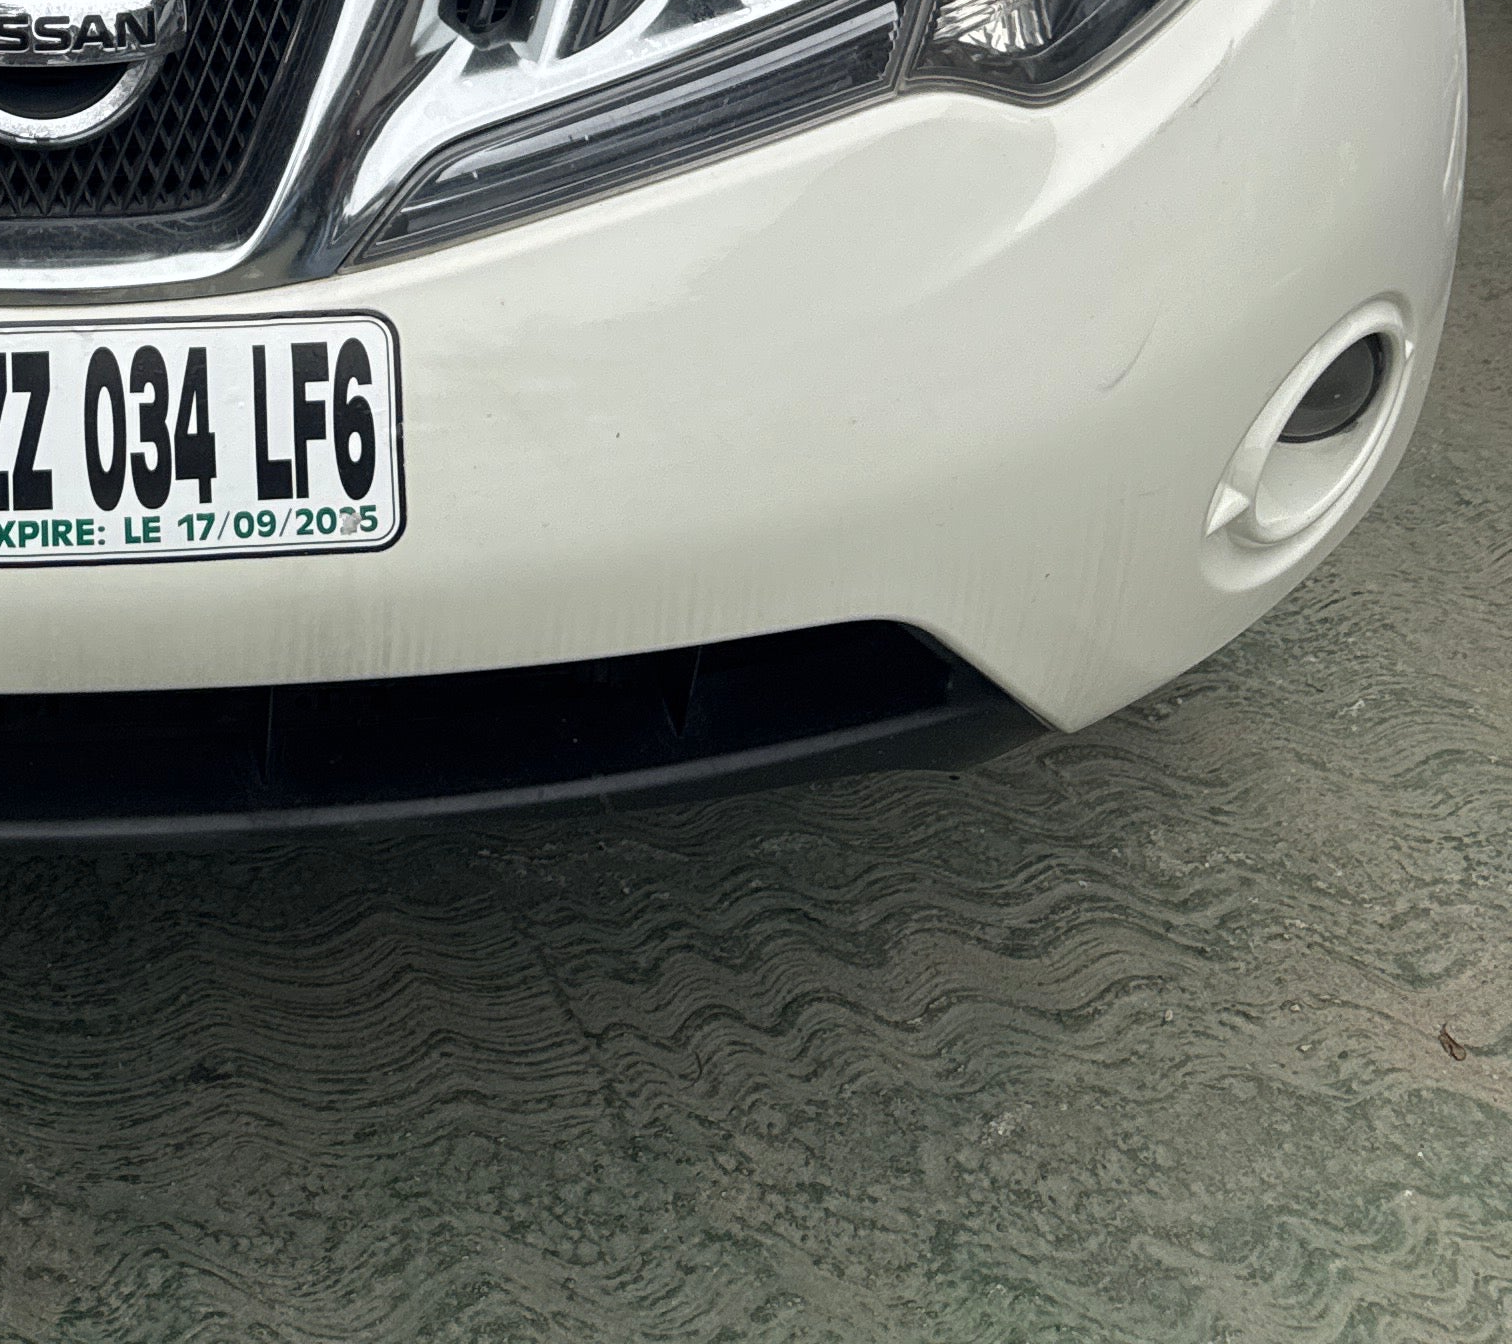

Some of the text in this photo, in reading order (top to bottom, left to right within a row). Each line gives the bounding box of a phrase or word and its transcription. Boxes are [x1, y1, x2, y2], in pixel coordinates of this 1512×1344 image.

[84, 346, 216, 511] 034
[253, 338, 375, 500] LF6
[125, 516, 161, 544] LE
